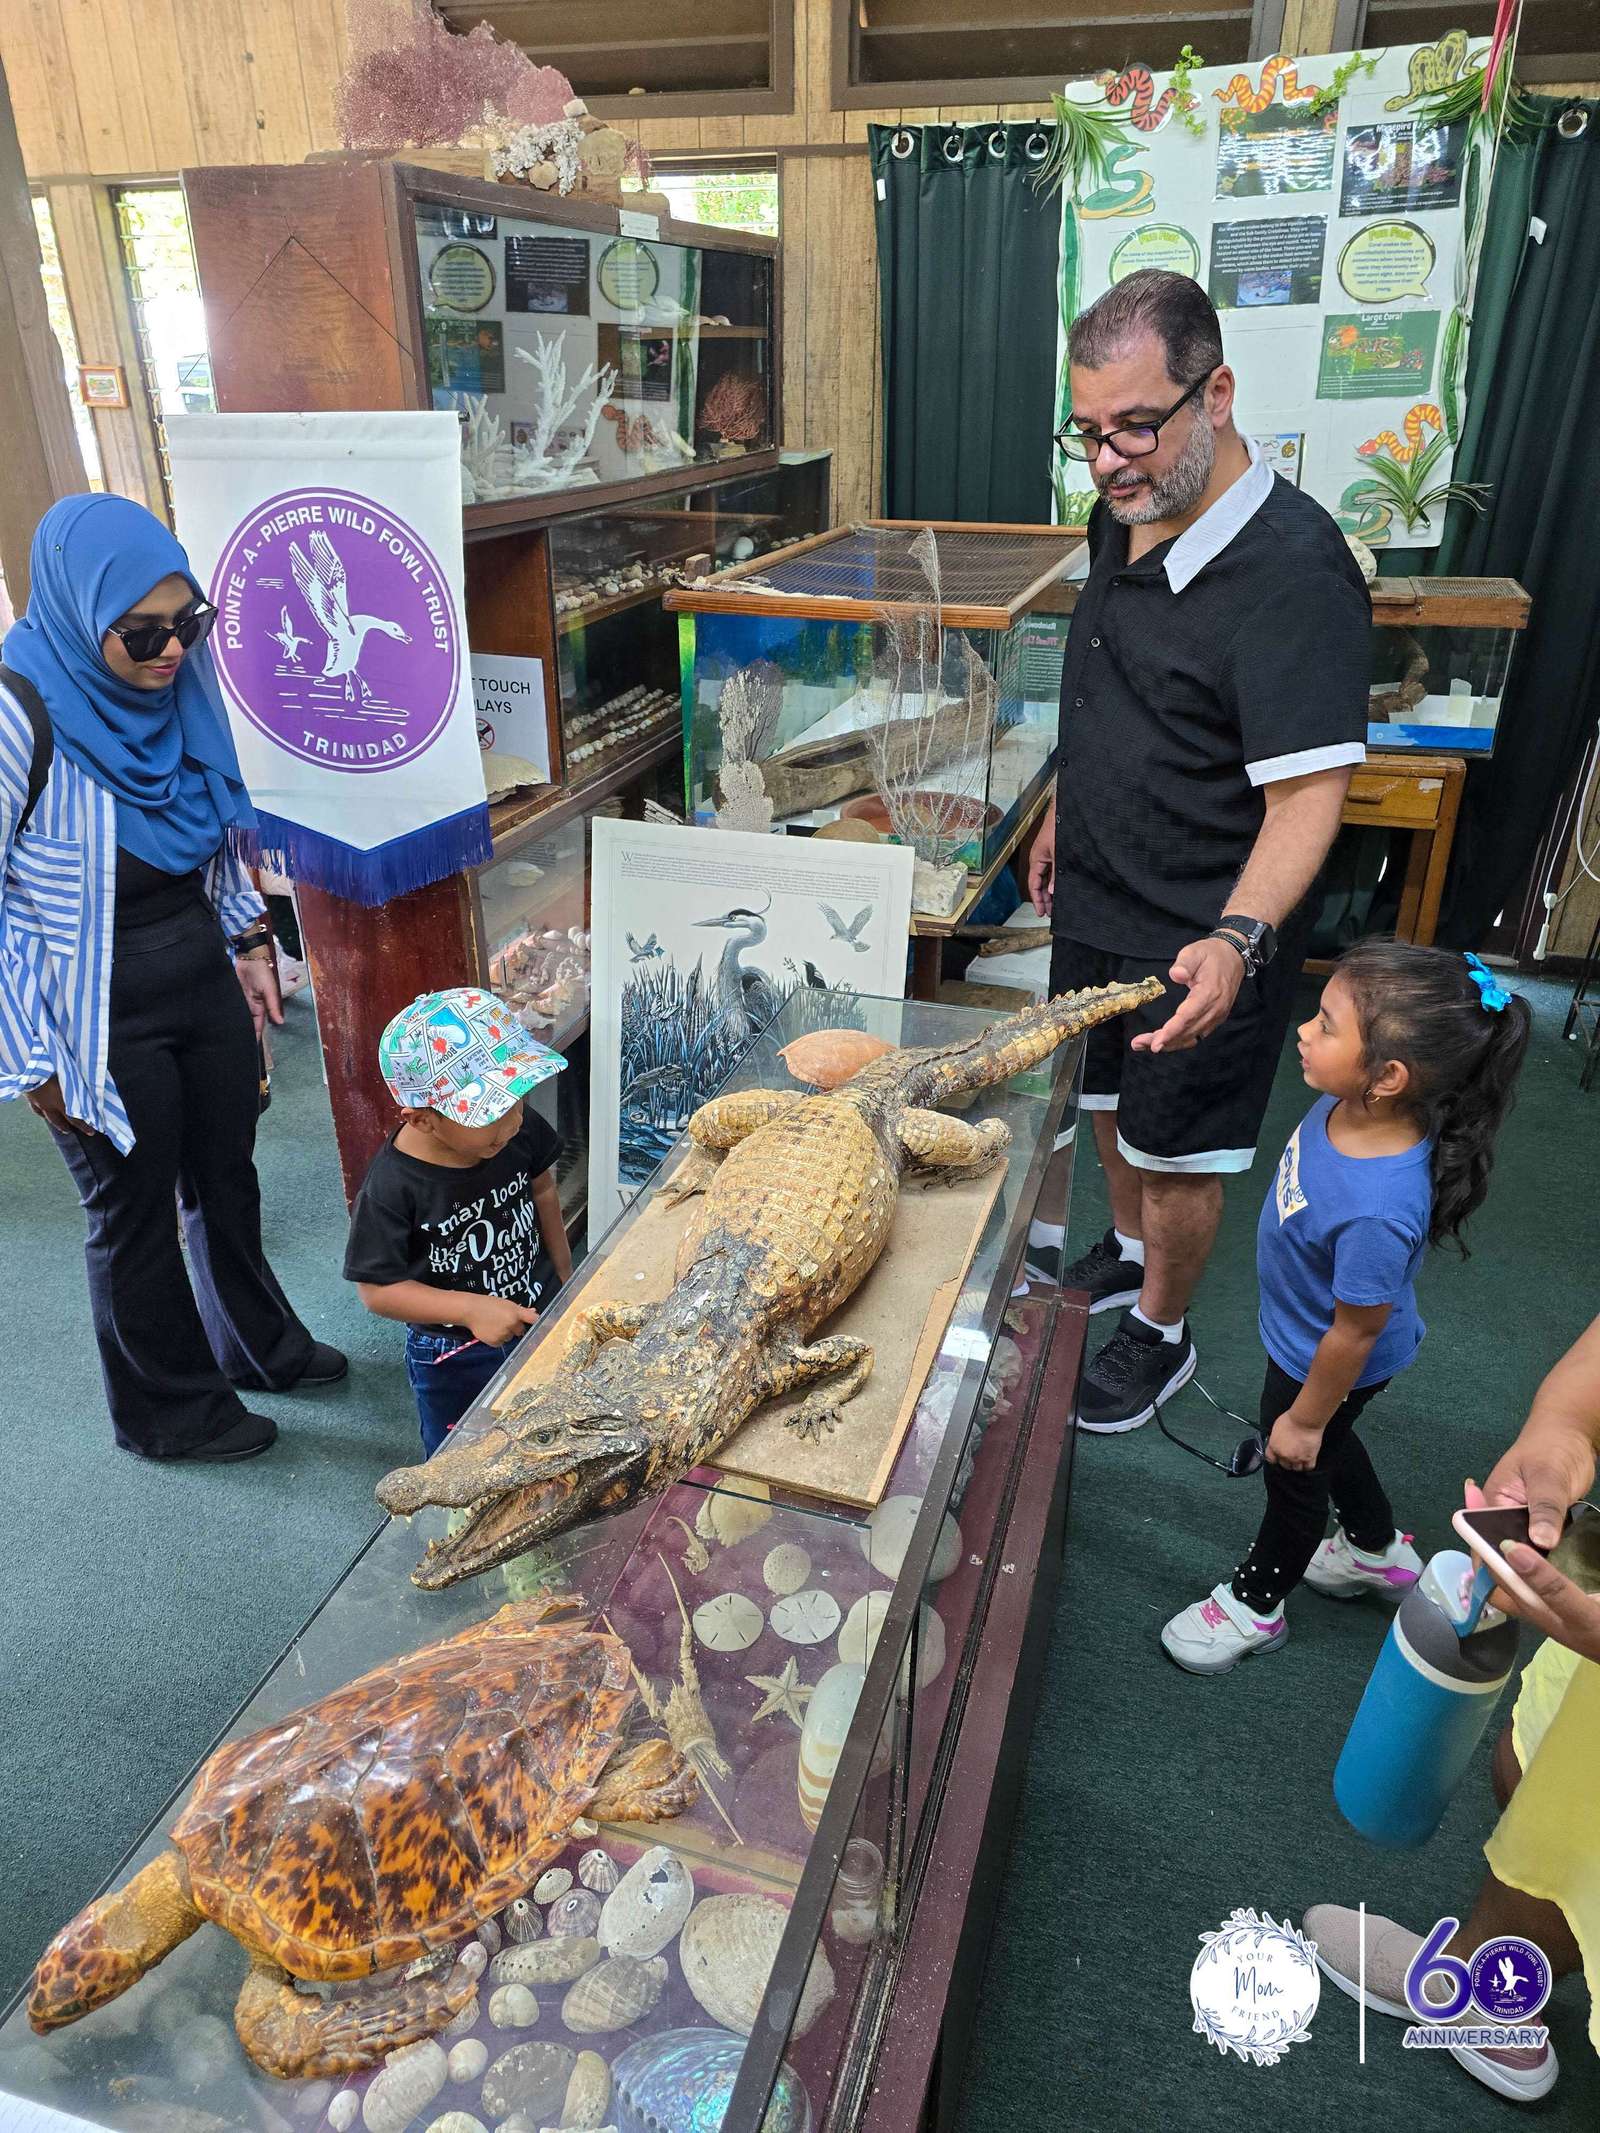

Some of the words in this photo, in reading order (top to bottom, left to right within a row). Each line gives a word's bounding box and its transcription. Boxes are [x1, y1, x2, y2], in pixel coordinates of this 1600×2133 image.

[1361, 313, 1383, 324] Large
[1384, 312, 1403, 321] Coral
[224, 573, 246, 649] POINTE
[242, 548, 258, 565] A
[260, 505, 324, 543] PIERRE
[328, 506, 376, 535] WILD
[378, 528, 424, 583] FOWL
[421, 581, 449, 653] TRUST
[479, 678, 531, 695] TOUCH
[474, 699, 512, 714] LAYS
[303, 731, 407, 759] TRINIDAD
[438, 1198, 485, 1236] may
[490, 1171, 528, 1208] look
[429, 1240, 467, 1262] like
[431, 1254, 460, 1273] my
[491, 1242, 524, 1271] but
[482, 1255, 525, 1290] have
